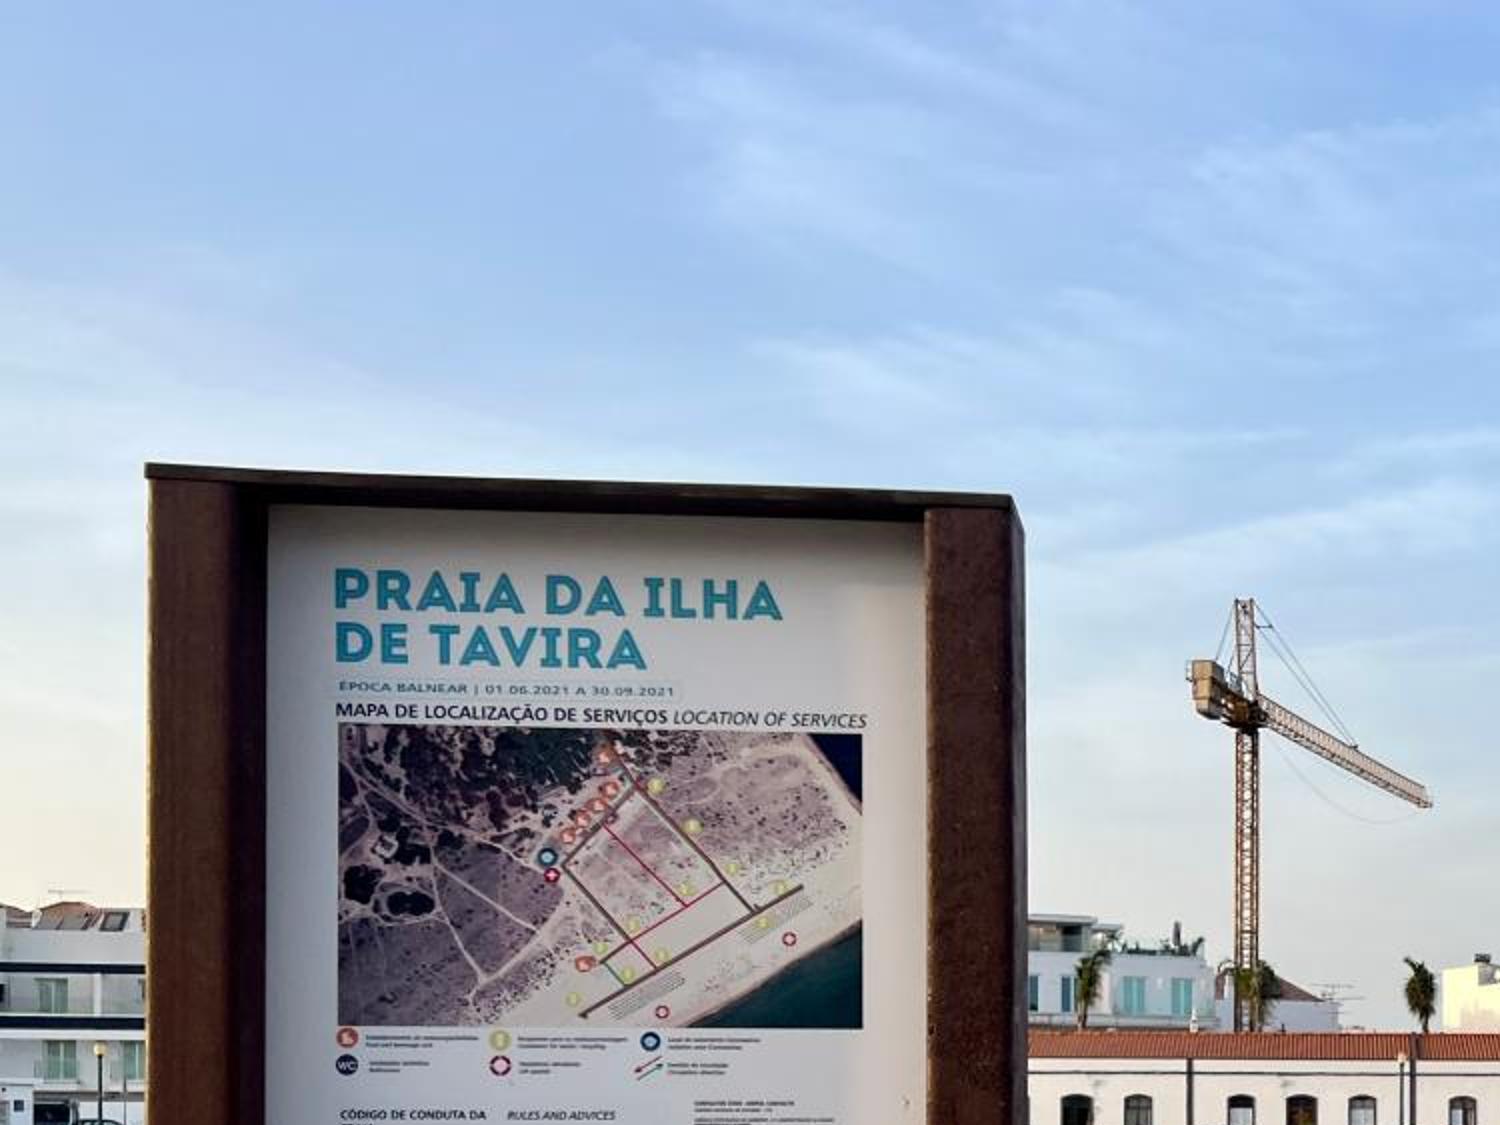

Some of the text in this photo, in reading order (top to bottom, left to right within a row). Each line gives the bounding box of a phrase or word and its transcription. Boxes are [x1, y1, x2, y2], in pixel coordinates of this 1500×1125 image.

[335, 567, 783, 621] PRAIA DA ILHA
[336, 621, 647, 671] DE TAVIRA
[399, 682, 468, 694] BALNEAR
[335, 703, 868, 728] MAPA DE LOCALIZAÇÃO DE SERVIÇOS LOCATION OF SERVICES
[391, 1110, 406, 1120] DE
[410, 1110, 466, 1120] CONDUTA
[470, 1110, 487, 1120] DA
[542, 1111, 567, 1121] AND
[570, 1110, 616, 1121] ADVICES
